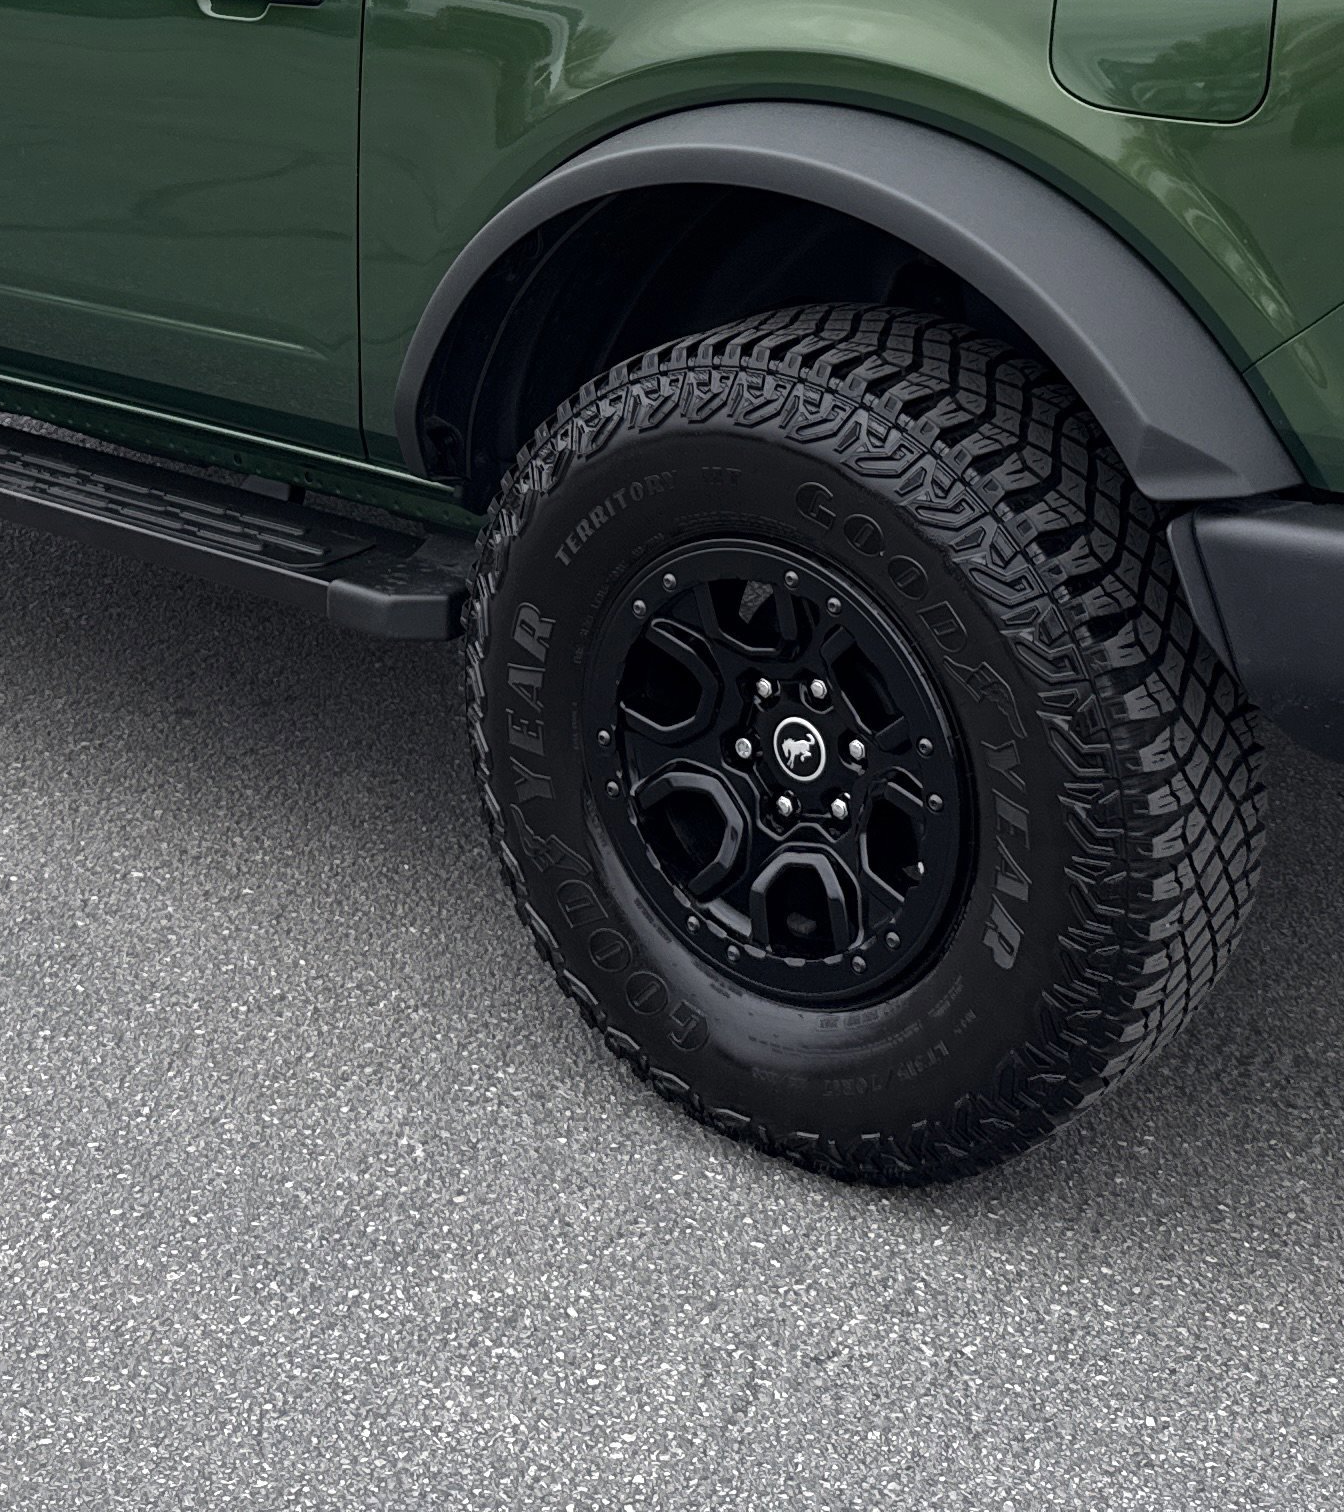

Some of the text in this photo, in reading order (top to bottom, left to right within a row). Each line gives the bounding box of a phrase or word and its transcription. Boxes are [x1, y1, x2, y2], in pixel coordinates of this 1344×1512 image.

[554, 469, 678, 567] TERRITORY
[795, 481, 1034, 971] GOODYEAR
[505, 601, 709, 1055] GOODYEAR
